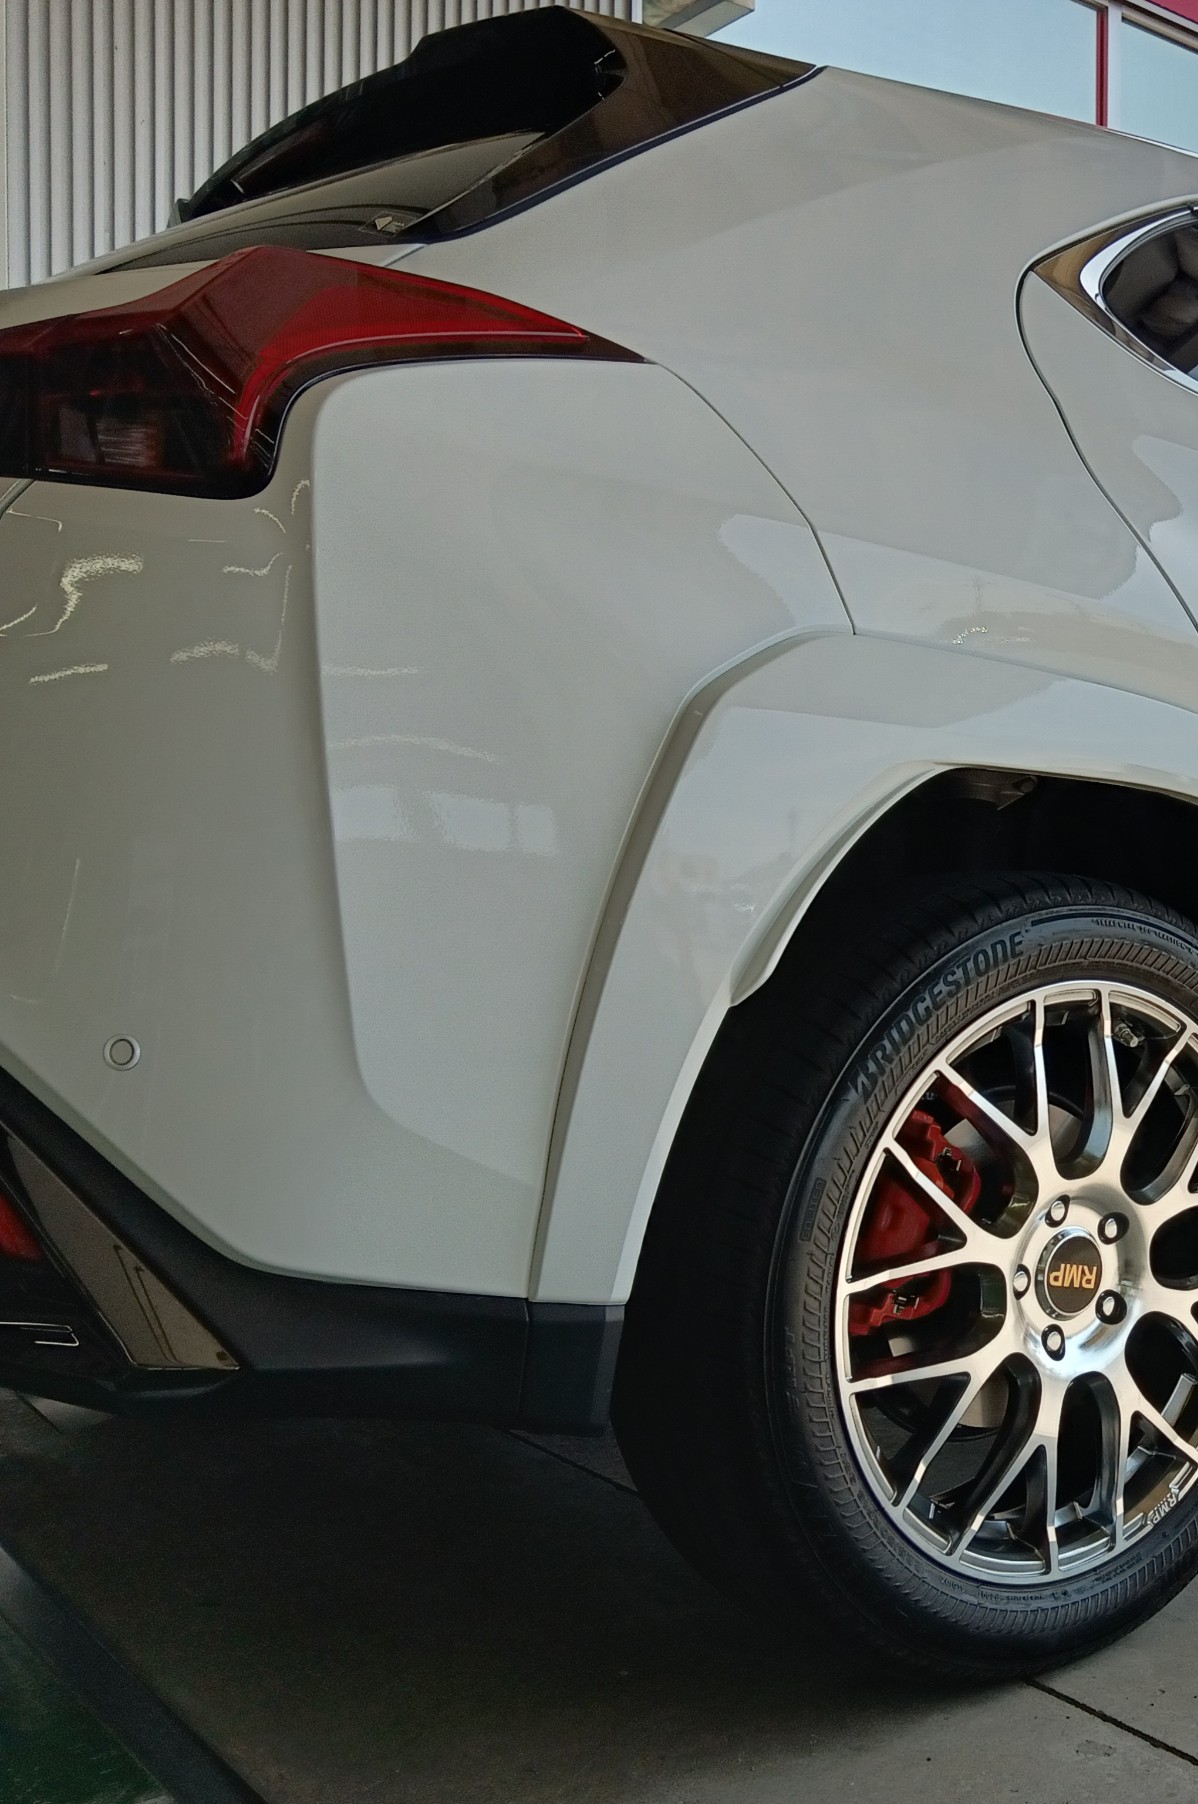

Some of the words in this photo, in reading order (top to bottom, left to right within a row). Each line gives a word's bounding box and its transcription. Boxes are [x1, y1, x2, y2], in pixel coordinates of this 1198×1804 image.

[849, 931, 1024, 1103] BRIDGESTONE
[1049, 1263, 1097, 1289] RMP
[1152, 1493, 1178, 1523] RMP
